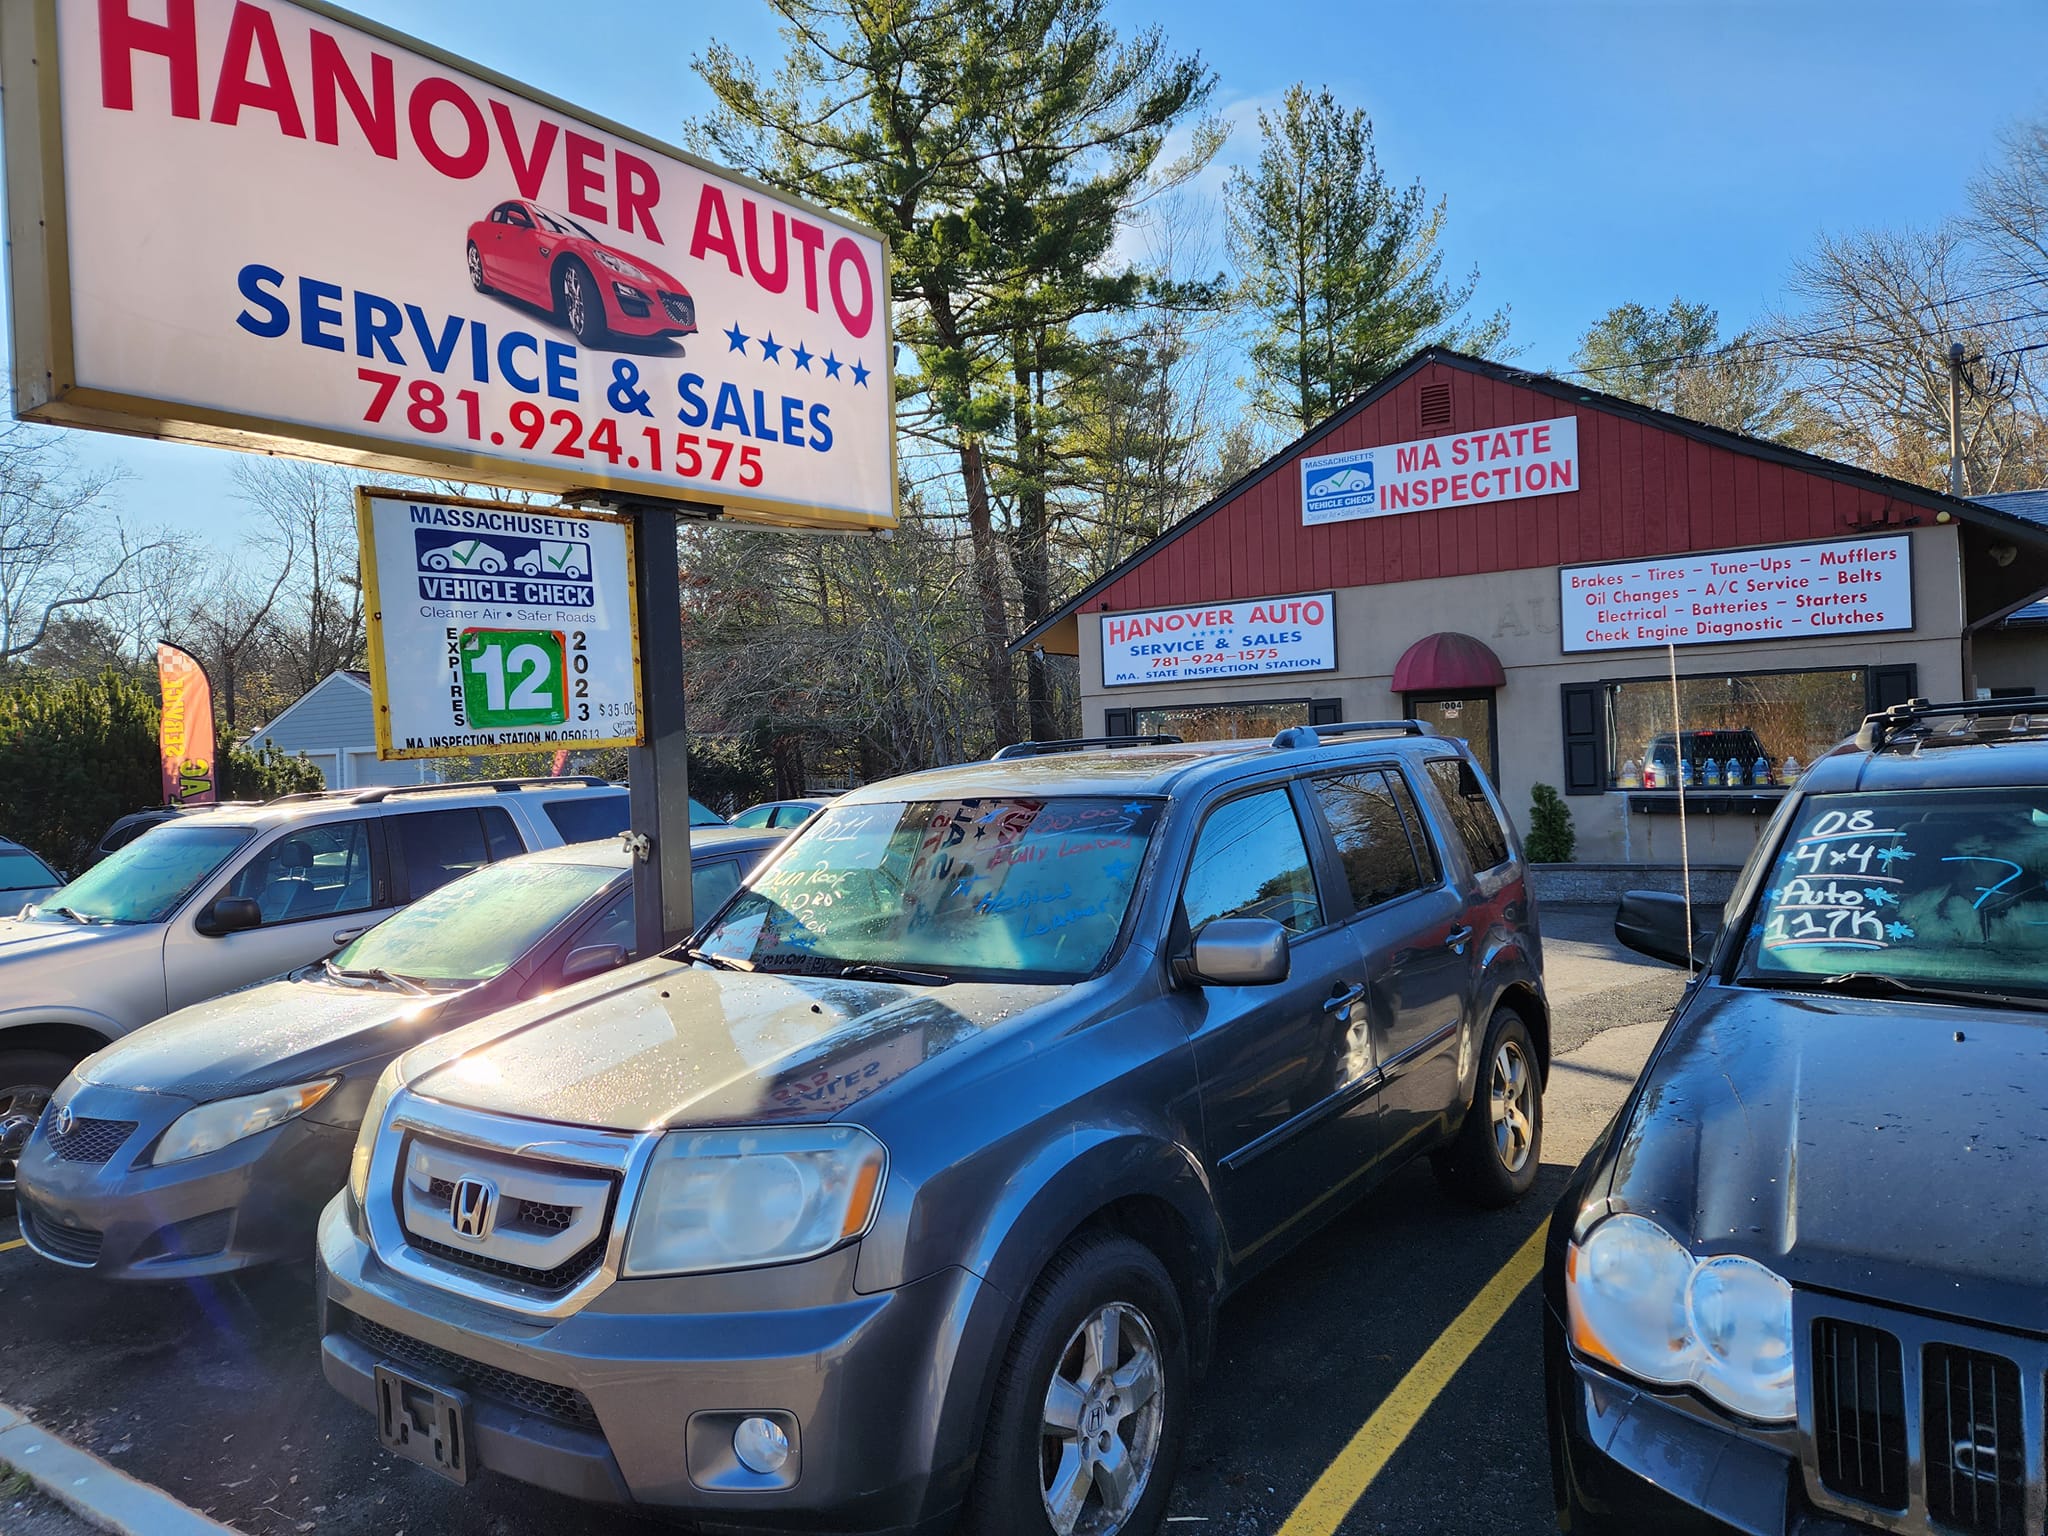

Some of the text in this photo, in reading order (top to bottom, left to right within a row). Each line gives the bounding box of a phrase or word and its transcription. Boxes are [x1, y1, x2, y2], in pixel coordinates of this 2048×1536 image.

[98, 0, 875, 339] HANOVER AUTO
[236, 263, 835, 453] SERVICE & SALES
[357, 368, 764, 488] 781.924.1575
[1304, 451, 1375, 469] MASSACHUSETTS
[1397, 425, 1552, 474] MA STATE
[1380, 459, 1573, 510] INSPECTION
[1309, 494, 1374, 511] VEHICLE CHECK
[409, 505, 590, 539] MASSACHUSETTS
[1571, 573, 1624, 589] Brakes
[1648, 568, 1685, 582] Tires
[1710, 557, 1791, 577] Tune-Ups
[1820, 547, 1898, 566] Mufflers
[422, 577, 592, 606] VEHICLE CHECK
[1586, 592, 1606, 606] Oil
[1613, 588, 1679, 605] Changes
[1705, 579, 1739, 597] A/C
[1747, 575, 1809, 593] Service
[1838, 569, 1882, 585] Belts
[420, 605, 596, 623] Cleaner Air Safer Roads
[1108, 600, 1325, 645] HANOVER AUTO
[1598, 605, 1667, 624] Electrical
[1692, 598, 1768, 616] Batteries
[1796, 590, 1868, 608] Starters
[1585, 627, 1630, 643] Check
[1637, 624, 1689, 642] Engine
[1696, 617, 1783, 636] Diagnostic
[1810, 610, 1885, 627] Clutches
[1130, 631, 1302, 657] SERVICE & SALES
[1151, 648, 1278, 668] 781-924-1575
[446, 627, 465, 726] EXPIRES
[471, 644, 553, 711] 12
[572, 631, 591, 721] 2023
[1116, 658, 1321, 681] MA. STATE INSPECTION STATION
[406, 737, 425, 748] MA
[429, 734, 495, 748] INSPECTION
[499, 731, 541, 744] STATION
[1811, 810, 1875, 837] 08
[1795, 843, 1876, 873] 4x4
[1780, 878, 1864, 906] Auto
[1766, 910, 1884, 941] 117K
